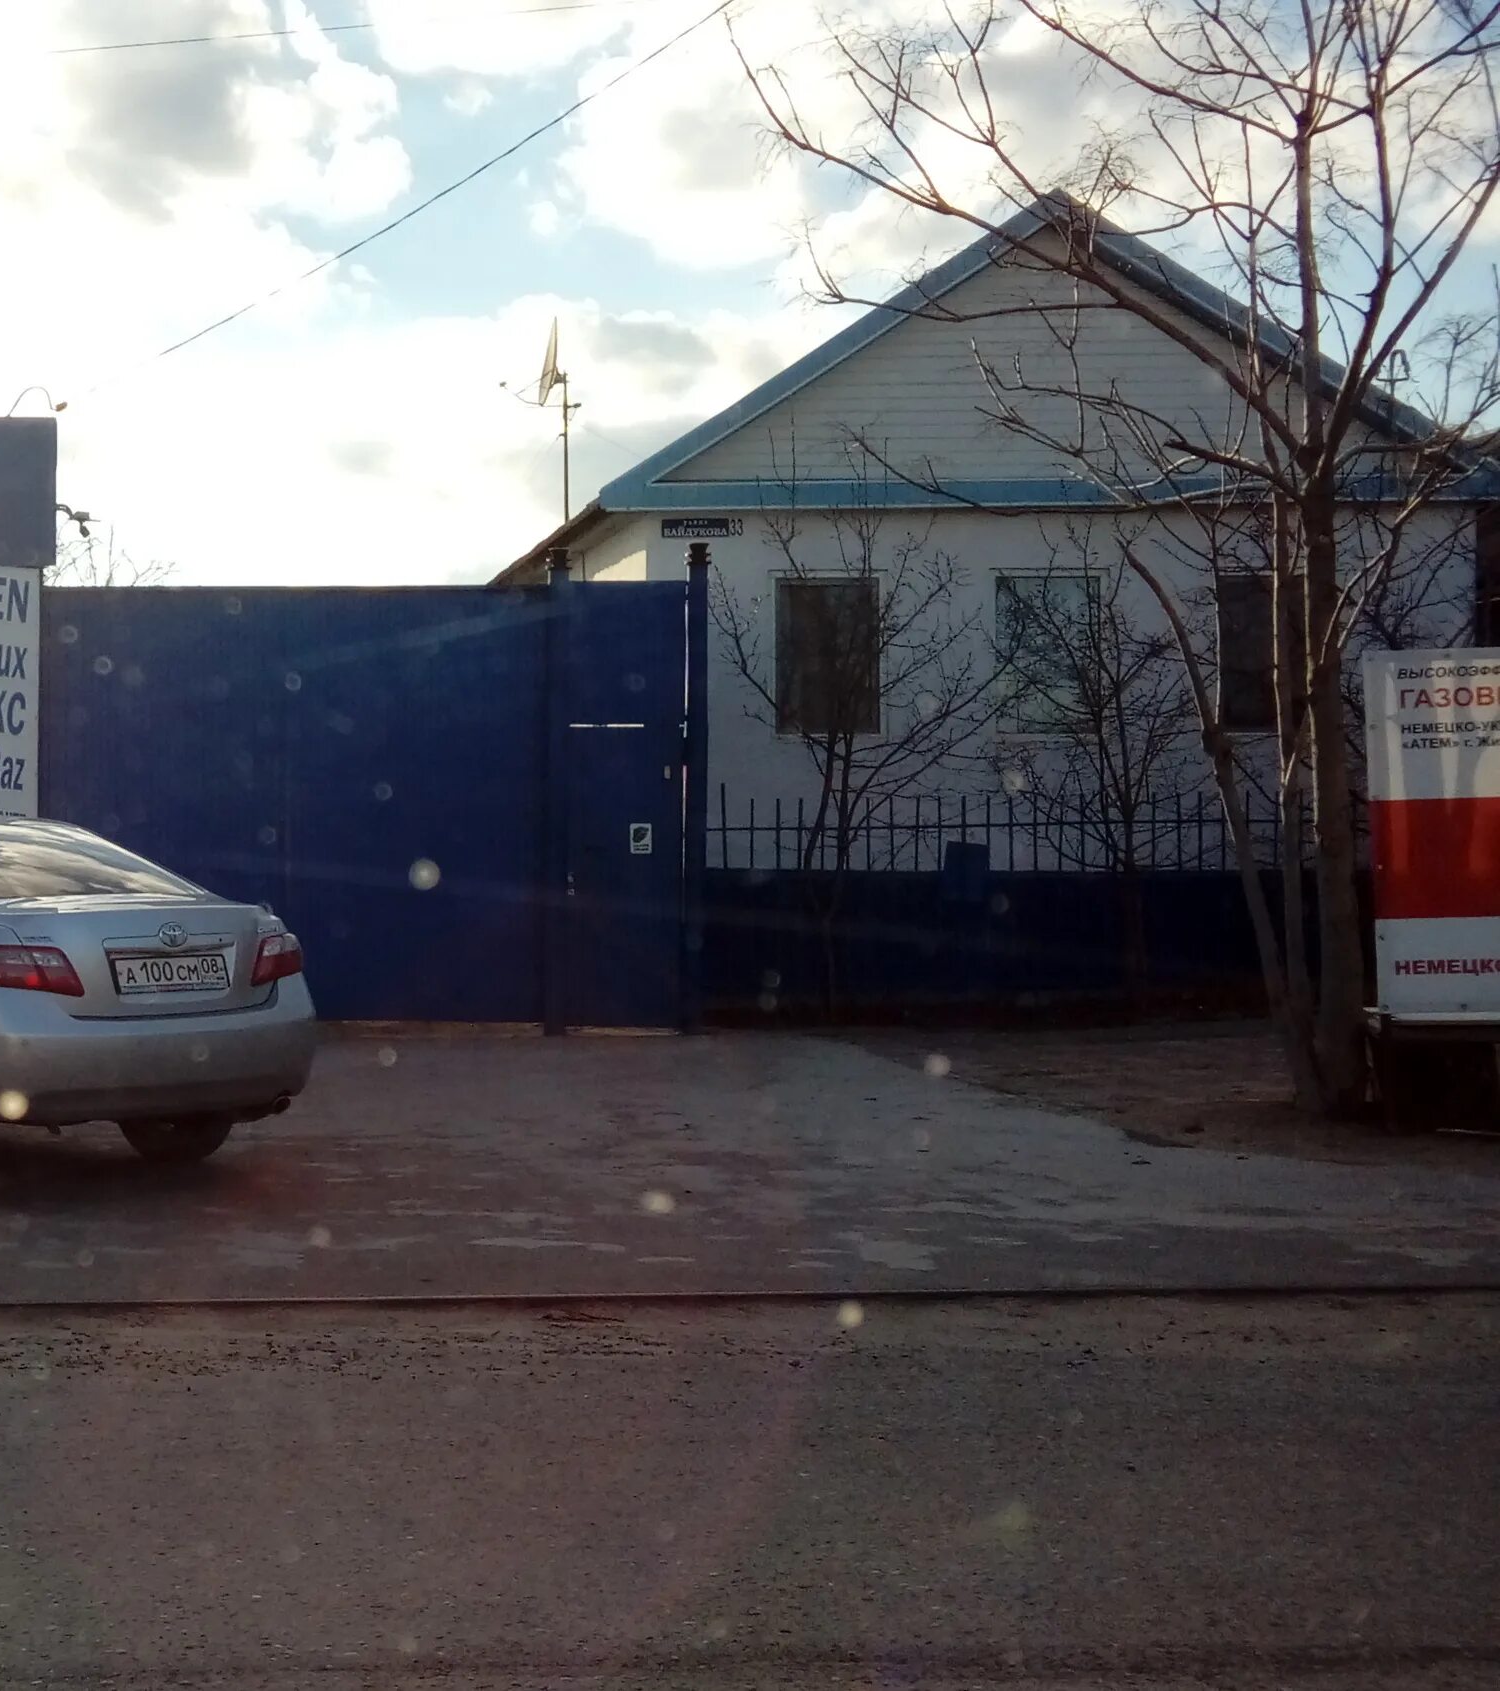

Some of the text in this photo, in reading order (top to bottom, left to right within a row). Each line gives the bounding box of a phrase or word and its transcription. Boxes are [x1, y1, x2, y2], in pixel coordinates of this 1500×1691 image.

[729, 519, 743, 536] 33
[1400, 686, 1500, 709] ГАЗОВ
[201, 958, 219, 974] 08
